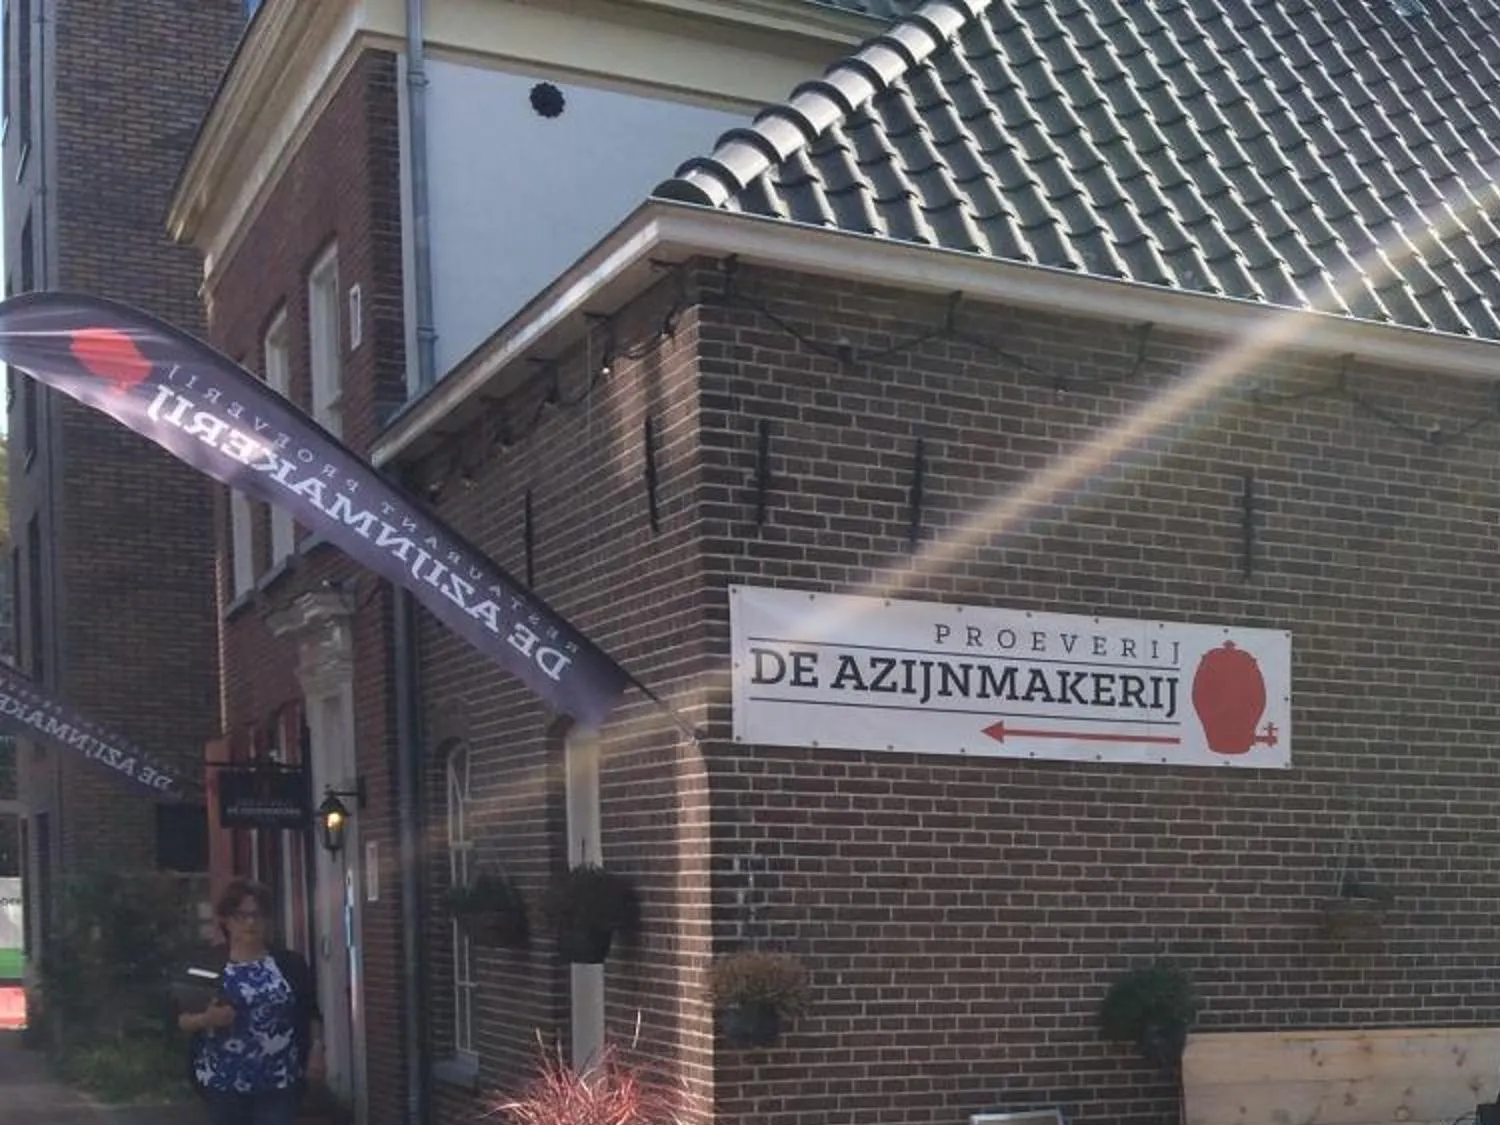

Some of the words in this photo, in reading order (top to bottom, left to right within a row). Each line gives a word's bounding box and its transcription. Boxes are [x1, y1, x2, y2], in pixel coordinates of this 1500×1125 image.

[934, 623, 1180, 664] PROEVERIJ
[751, 648, 818, 688] DE
[830, 655, 1179, 718] AZIJNMAKERIJ
